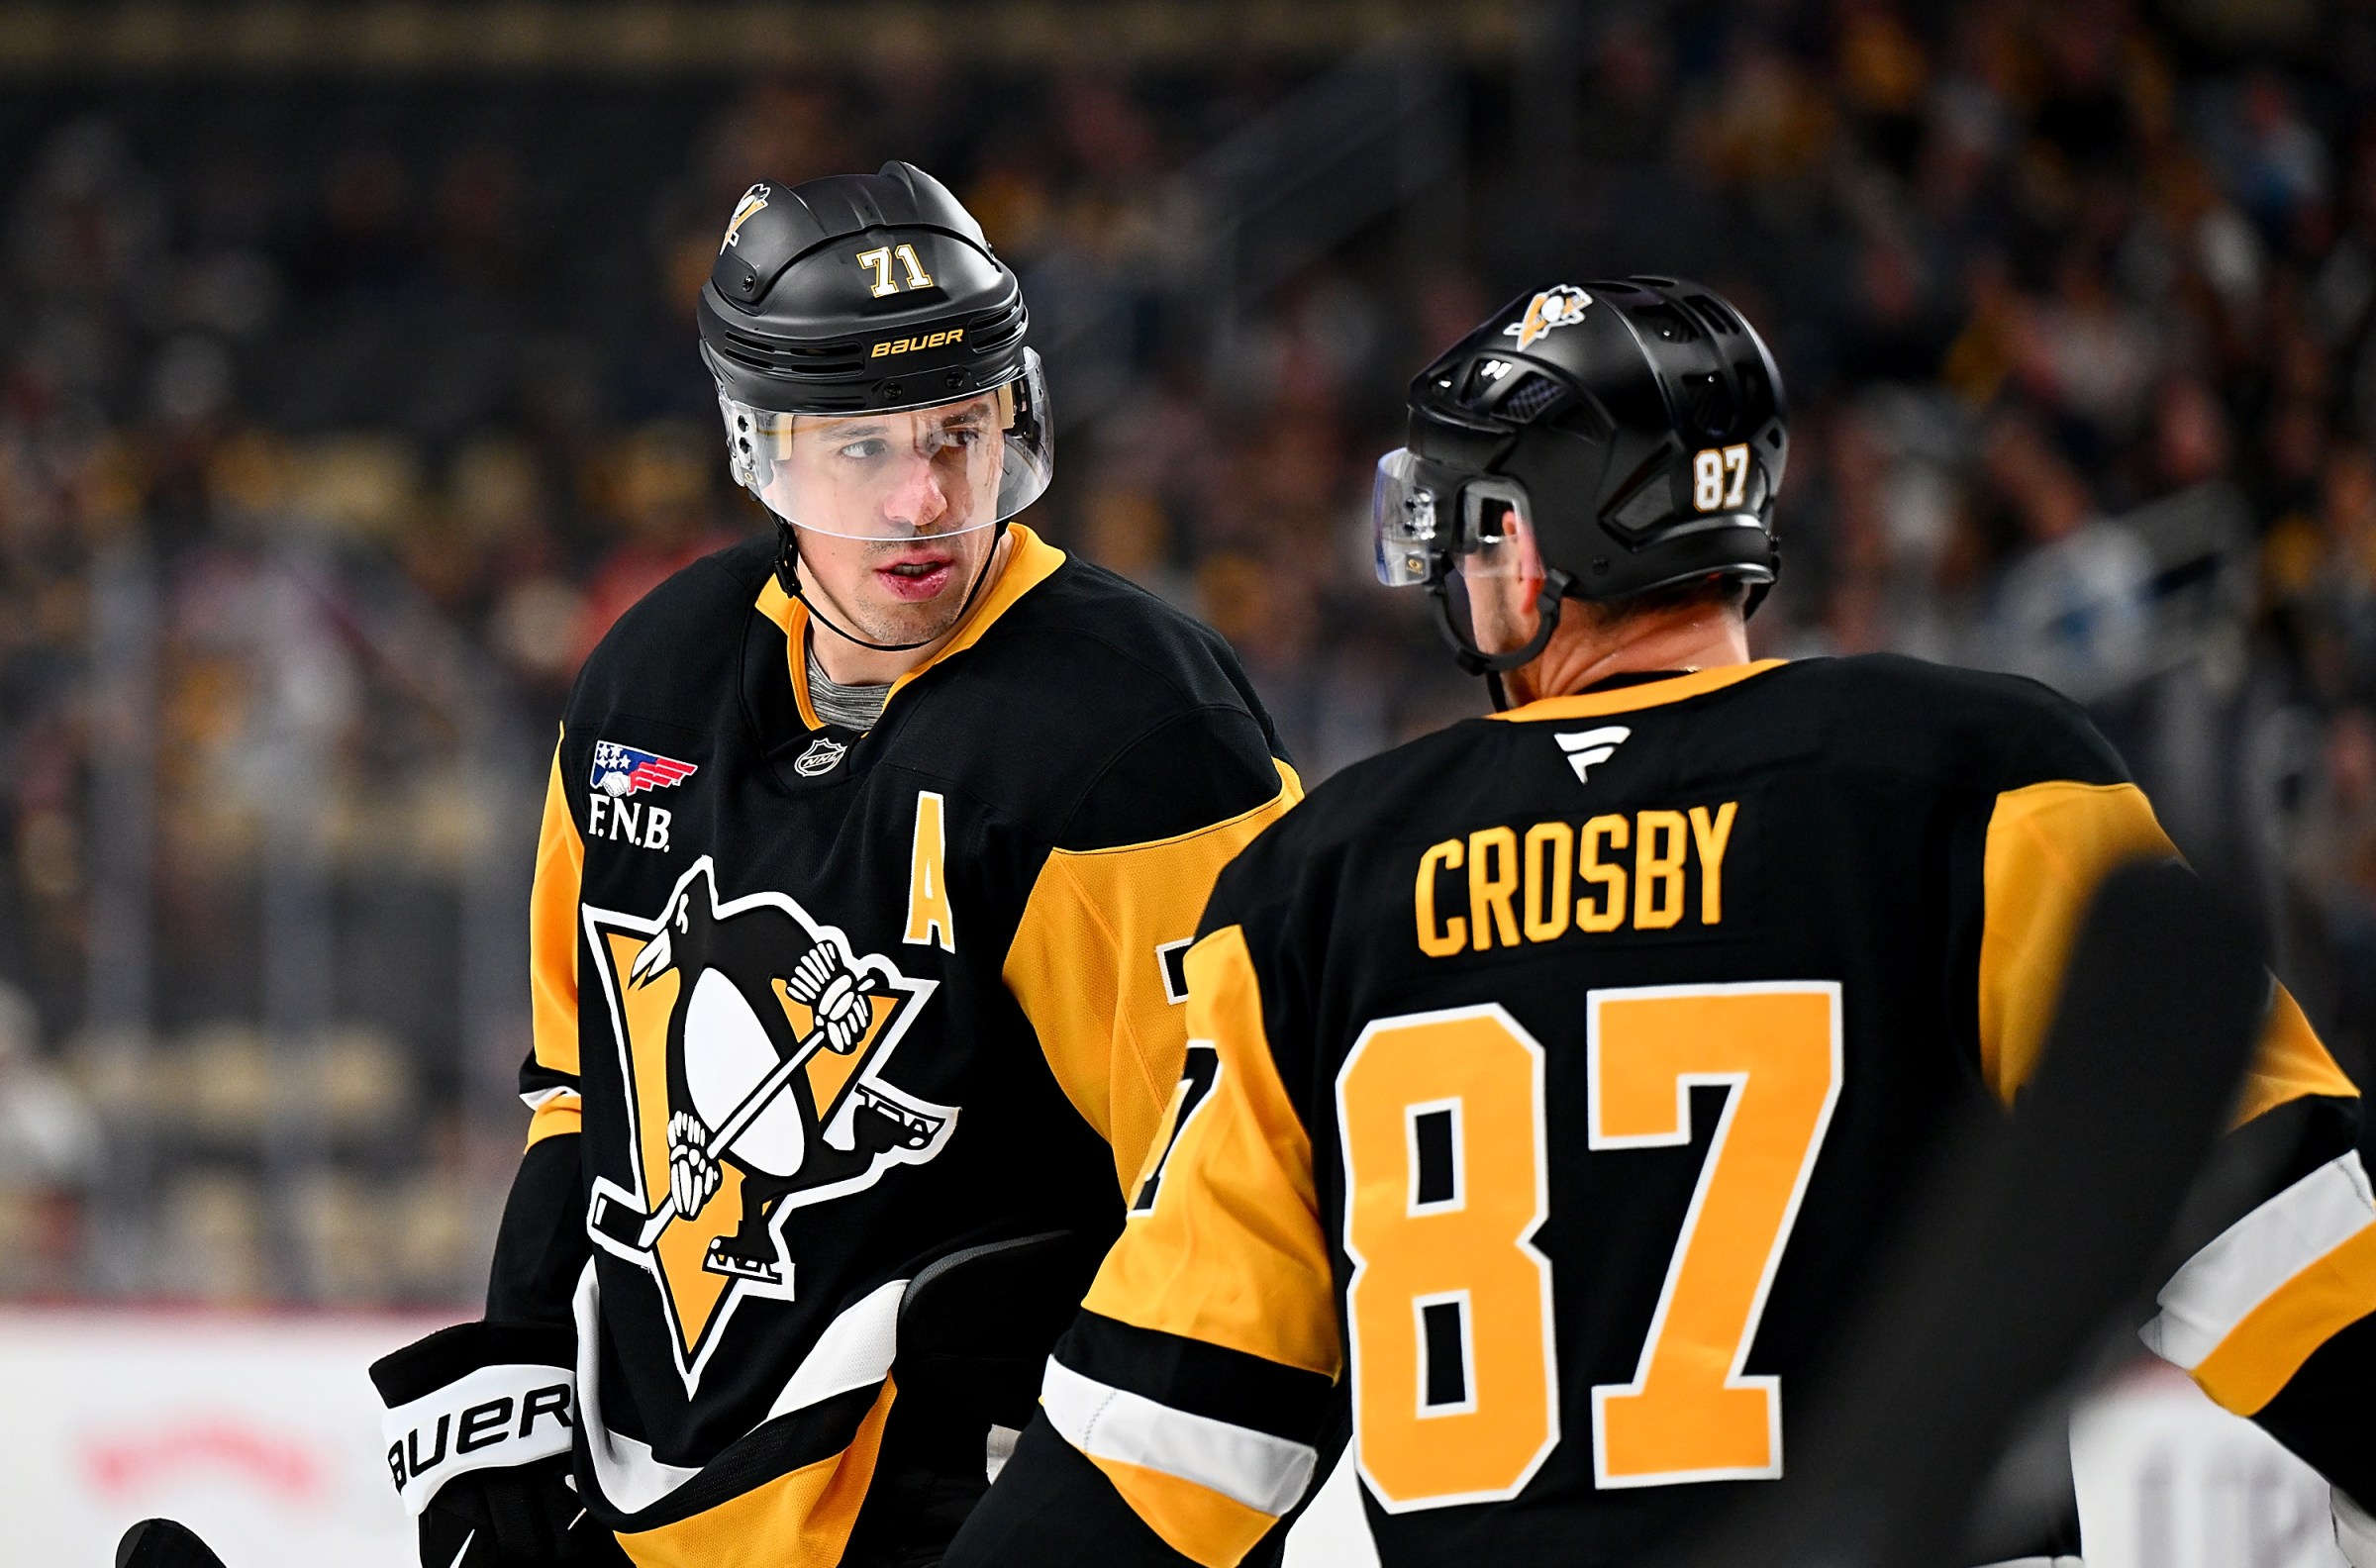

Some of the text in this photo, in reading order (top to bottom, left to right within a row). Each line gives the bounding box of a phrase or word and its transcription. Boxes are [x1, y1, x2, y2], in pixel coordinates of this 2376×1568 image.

[856, 244, 934, 298] 71
[1693, 442, 1749, 513] 87
[588, 793, 672, 852] F.N.B.
[902, 791, 955, 954] A
[1415, 801, 1738, 958] CROSBY
[1335, 980, 1843, 1515] 87
